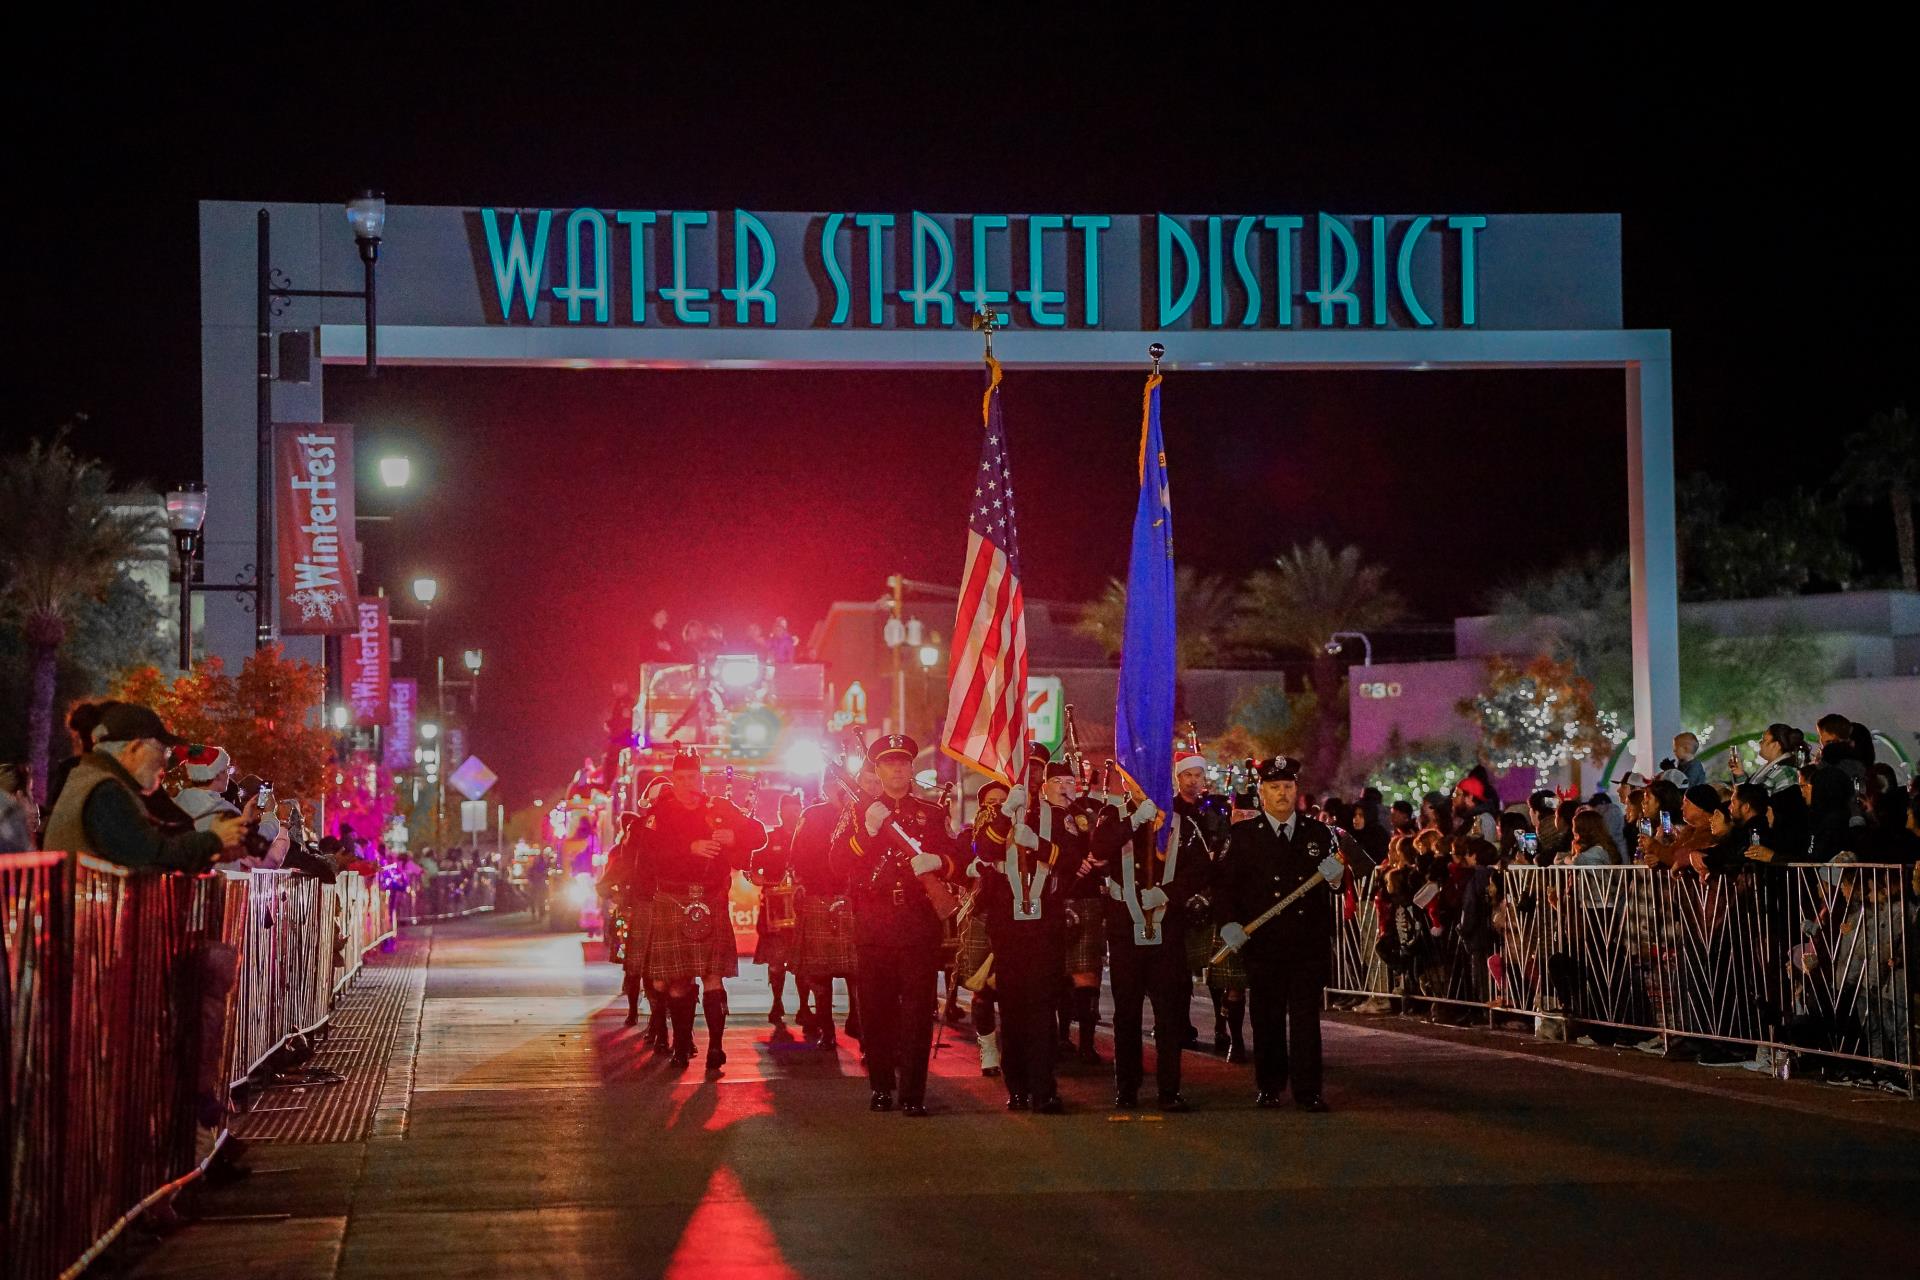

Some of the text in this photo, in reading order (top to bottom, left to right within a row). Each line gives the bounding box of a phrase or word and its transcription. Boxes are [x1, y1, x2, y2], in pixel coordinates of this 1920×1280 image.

[481, 208, 1487, 328] WATER STREET DISTRICT
